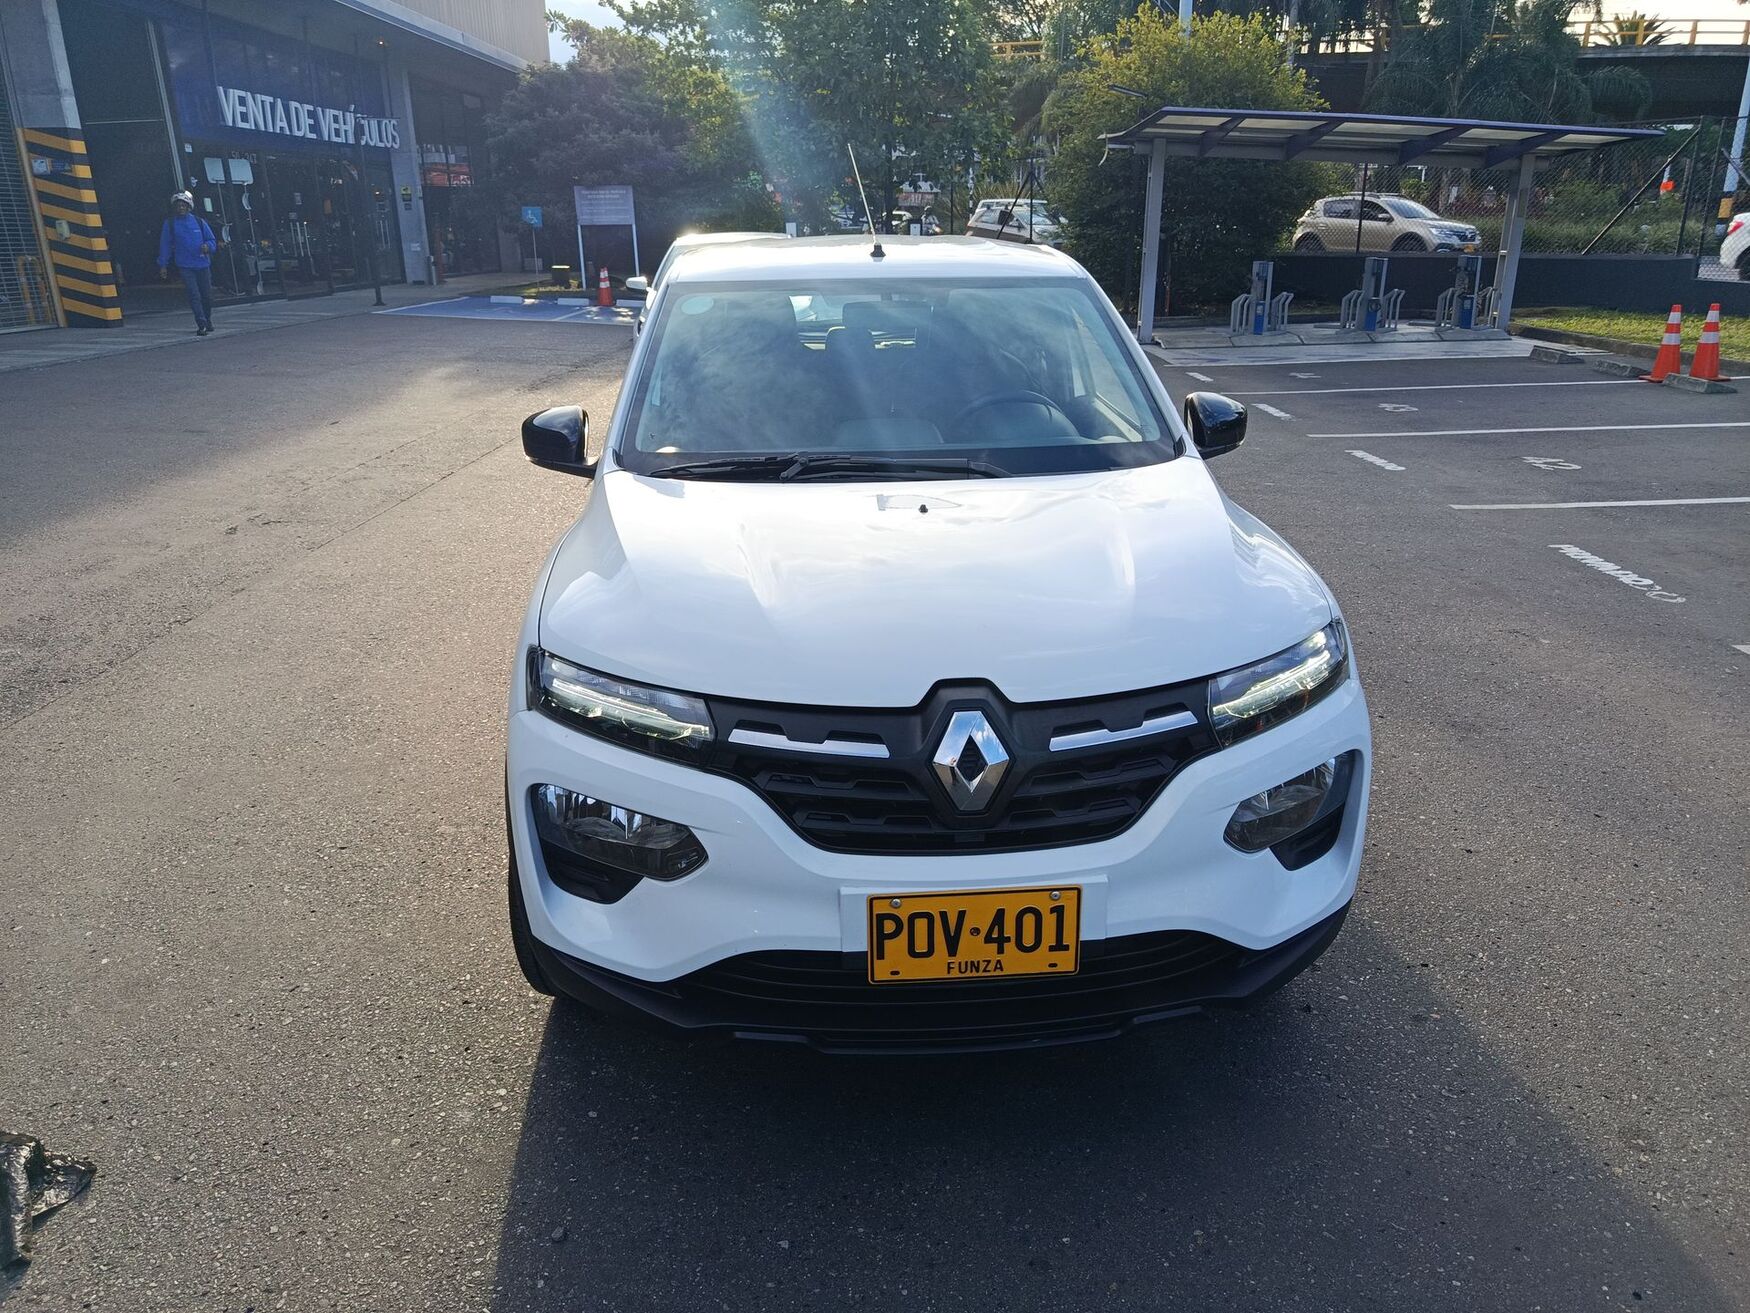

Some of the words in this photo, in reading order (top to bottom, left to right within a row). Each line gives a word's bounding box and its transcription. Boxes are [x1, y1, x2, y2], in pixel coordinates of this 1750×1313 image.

[216, 85, 290, 135] VENTA
[289, 100, 317, 139] DE
[1521, 456, 1582, 471] 42
[946, 959, 1005, 975] FUNZA
